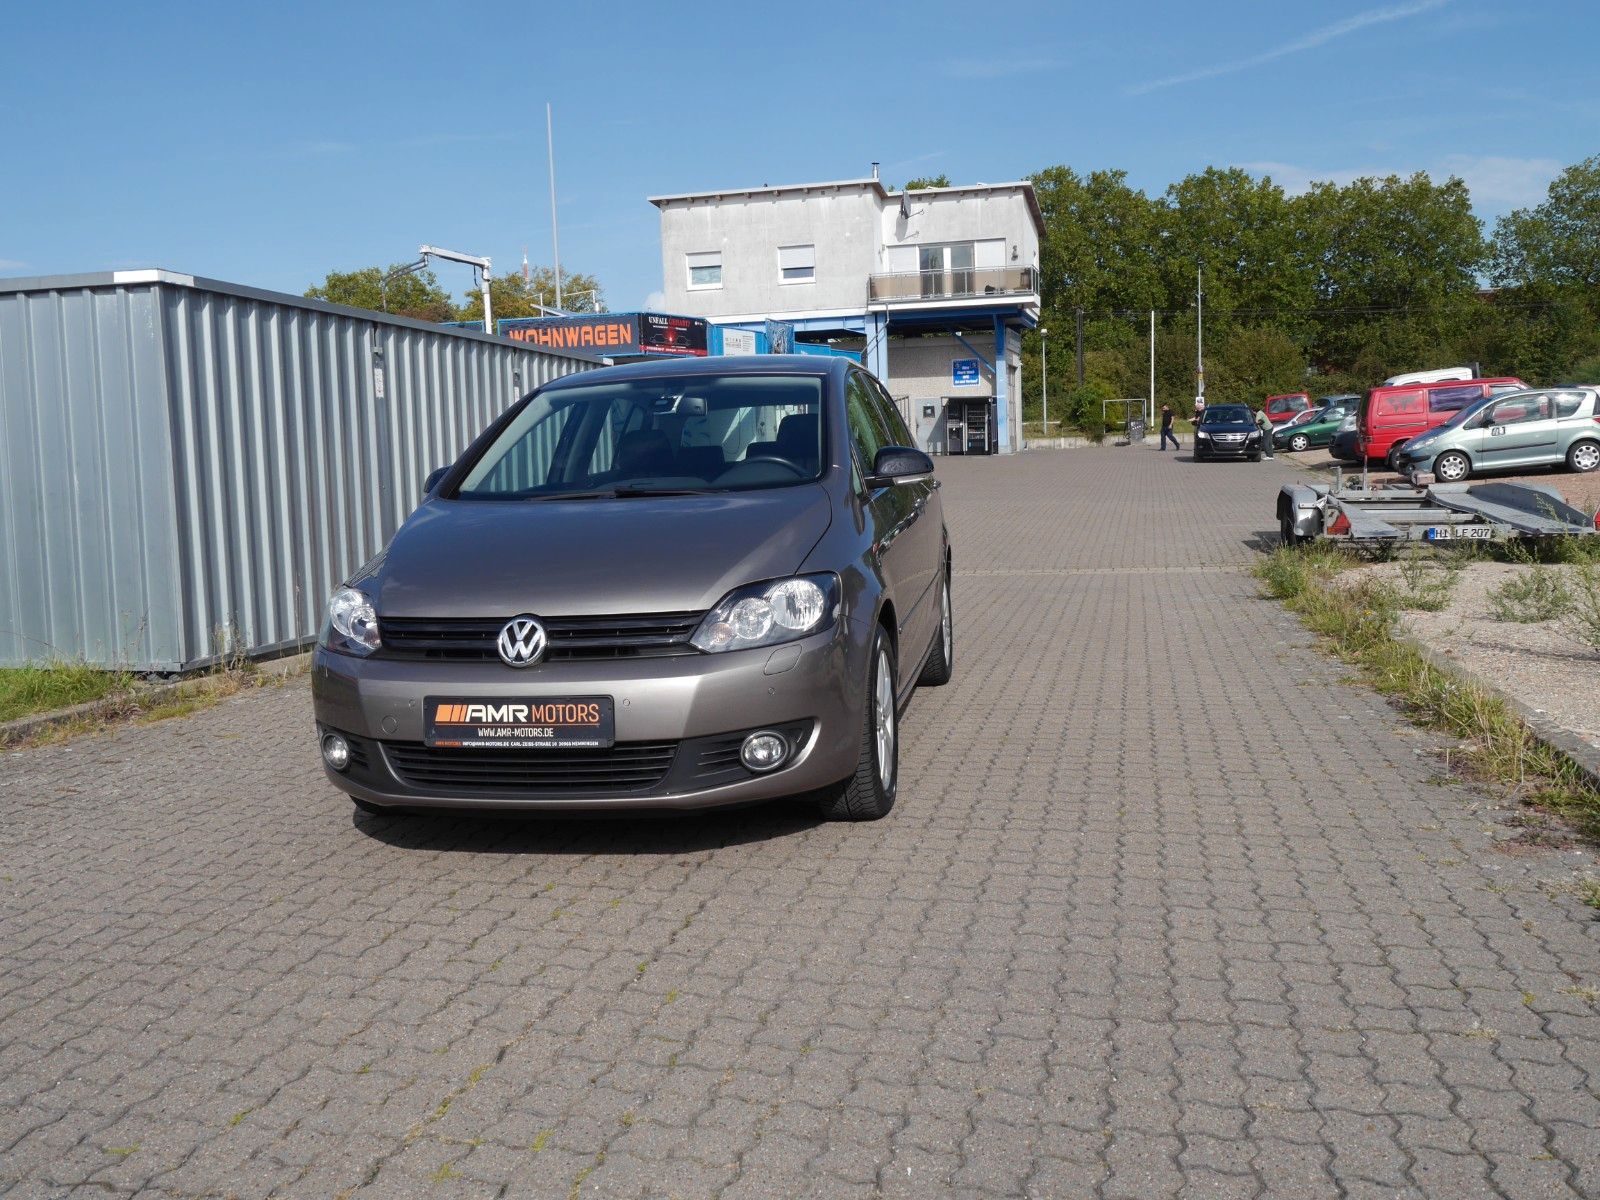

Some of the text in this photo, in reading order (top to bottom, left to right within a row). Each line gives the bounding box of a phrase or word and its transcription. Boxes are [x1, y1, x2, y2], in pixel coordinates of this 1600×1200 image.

[648, 316, 668, 325] UNFALL
[508, 323, 632, 348] WOHNWAGEN
[1470, 528, 1490, 538] 207
[464, 703, 600, 723] AMR MOTORS
[477, 727, 554, 738] WWW.AMR-MOTORS.DE
